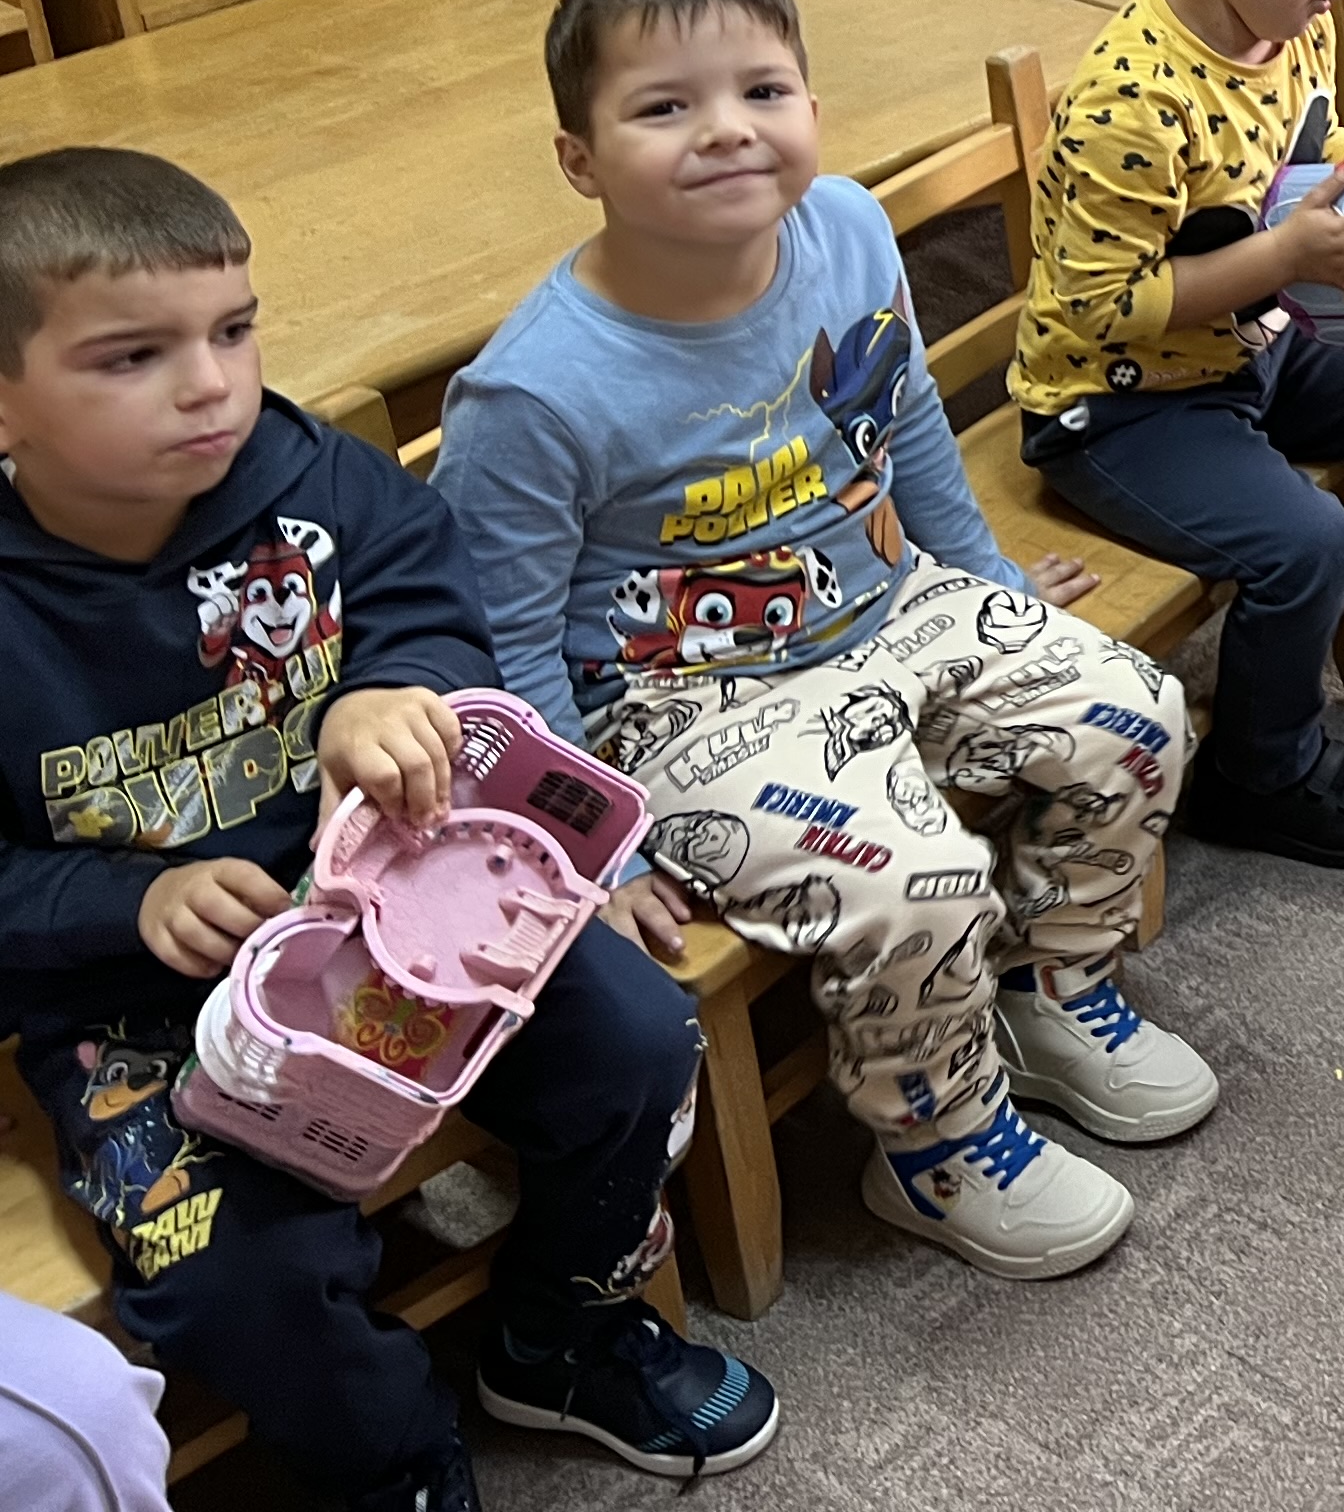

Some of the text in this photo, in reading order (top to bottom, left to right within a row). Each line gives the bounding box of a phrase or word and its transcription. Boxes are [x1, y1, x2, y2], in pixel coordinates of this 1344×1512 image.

[659, 464, 828, 545] POWER
[685, 435, 809, 516] PAW
[751, 782, 860, 829] AMERICA
[794, 825, 893, 872] CAPTAIN
